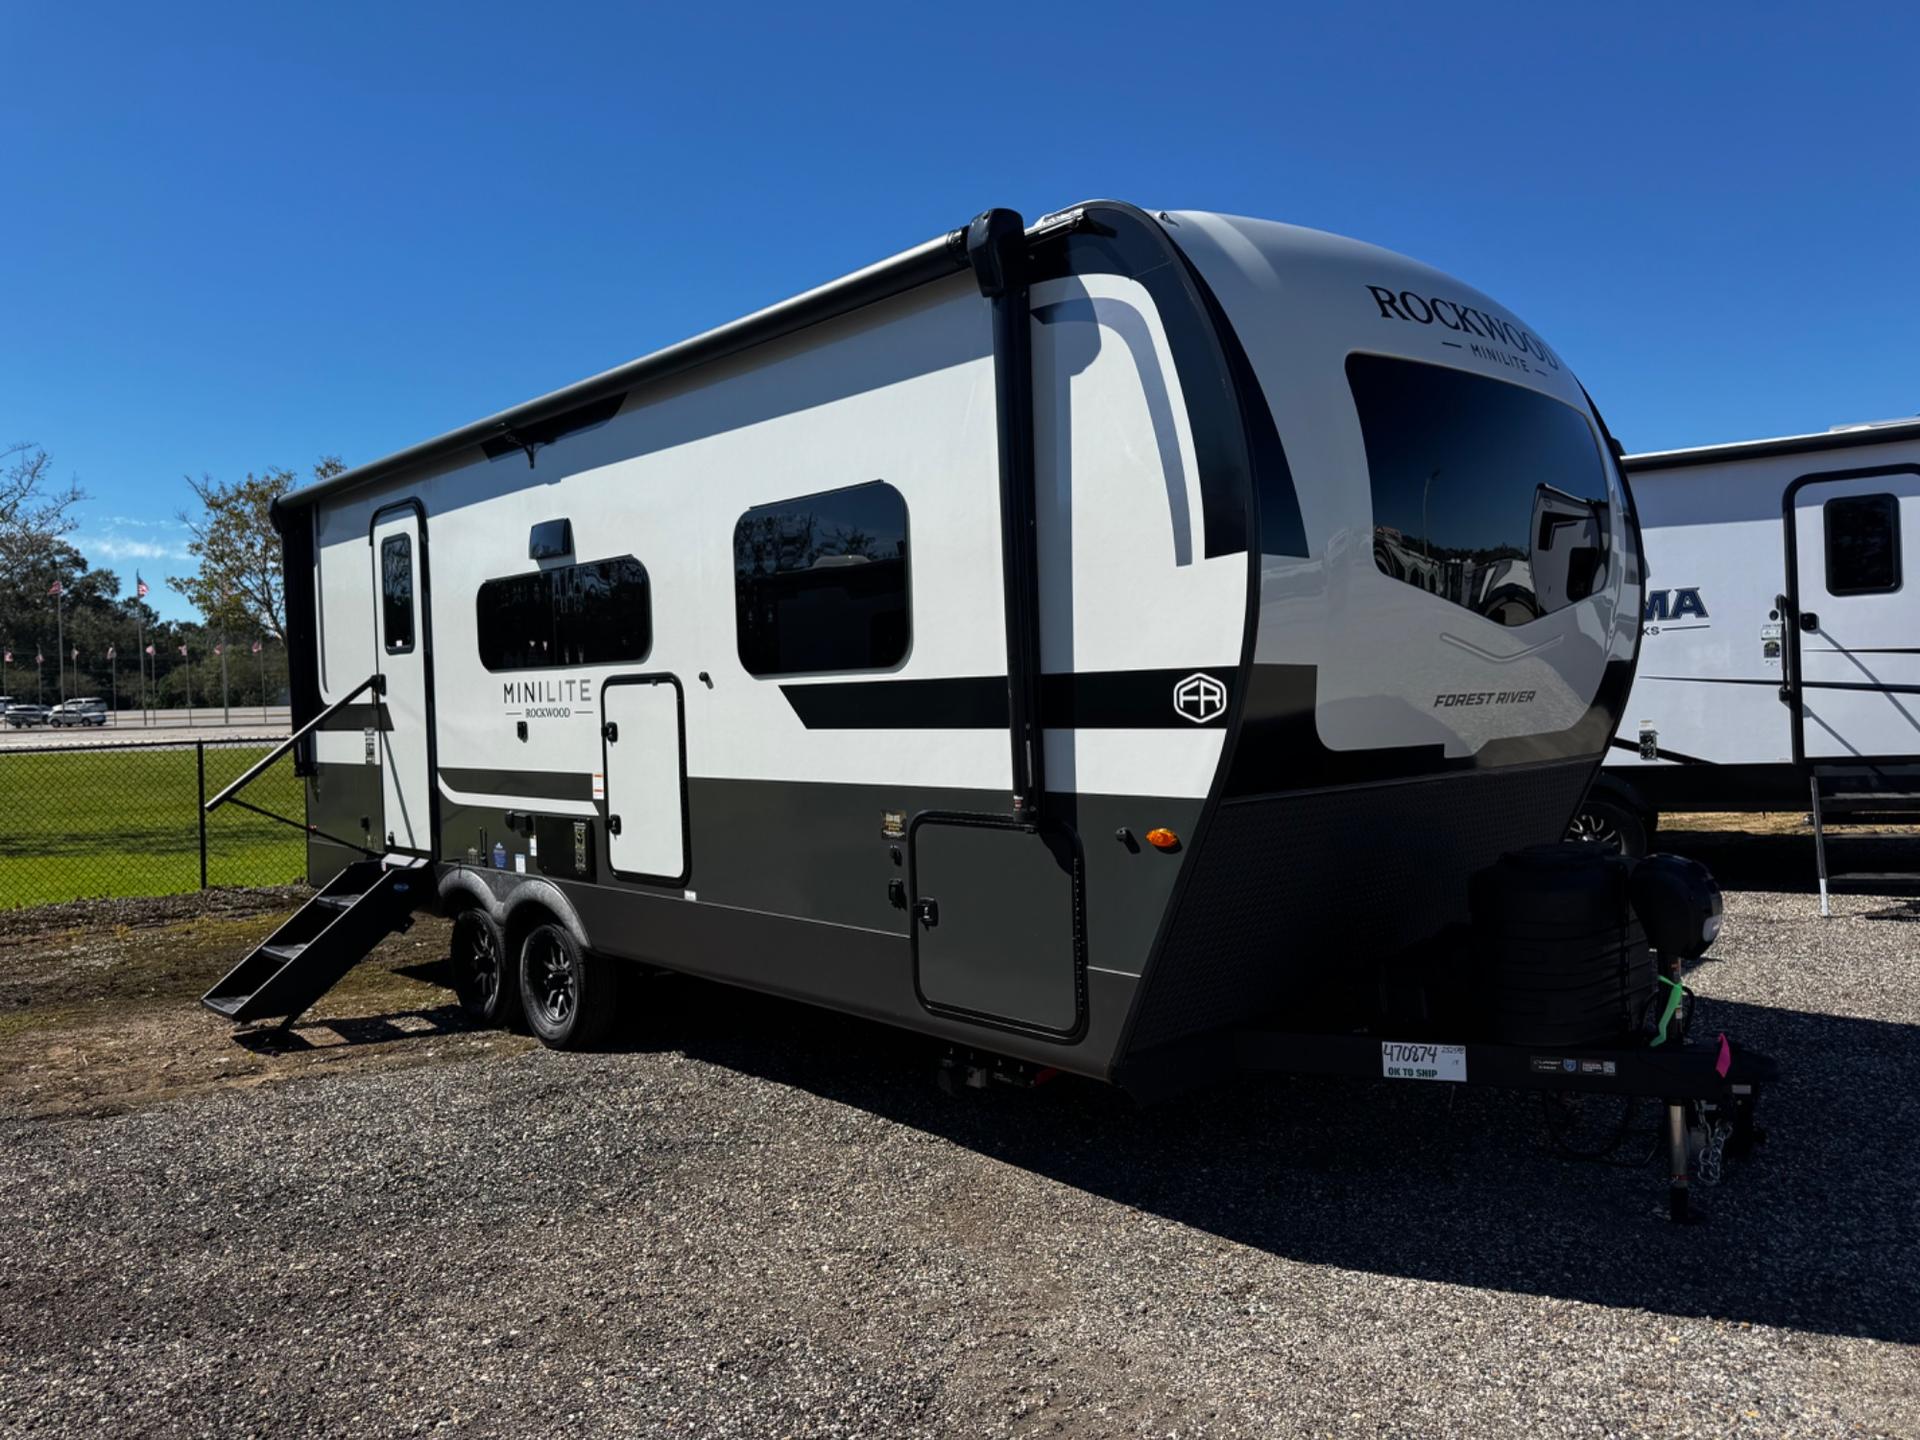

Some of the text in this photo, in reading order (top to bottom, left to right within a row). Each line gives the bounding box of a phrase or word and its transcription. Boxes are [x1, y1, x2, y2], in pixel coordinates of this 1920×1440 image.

[1365, 285, 1559, 370] ROCKWOOD
[1471, 343, 1529, 373] MINILITE
[504, 680, 592, 703] MINILITE
[1433, 690, 1536, 708] FOREST RIVER
[525, 708, 571, 718] ROCKWOOD
[1383, 1044, 1438, 1064] 470874
[1388, 1067, 1438, 1078] OK TO SHIP
